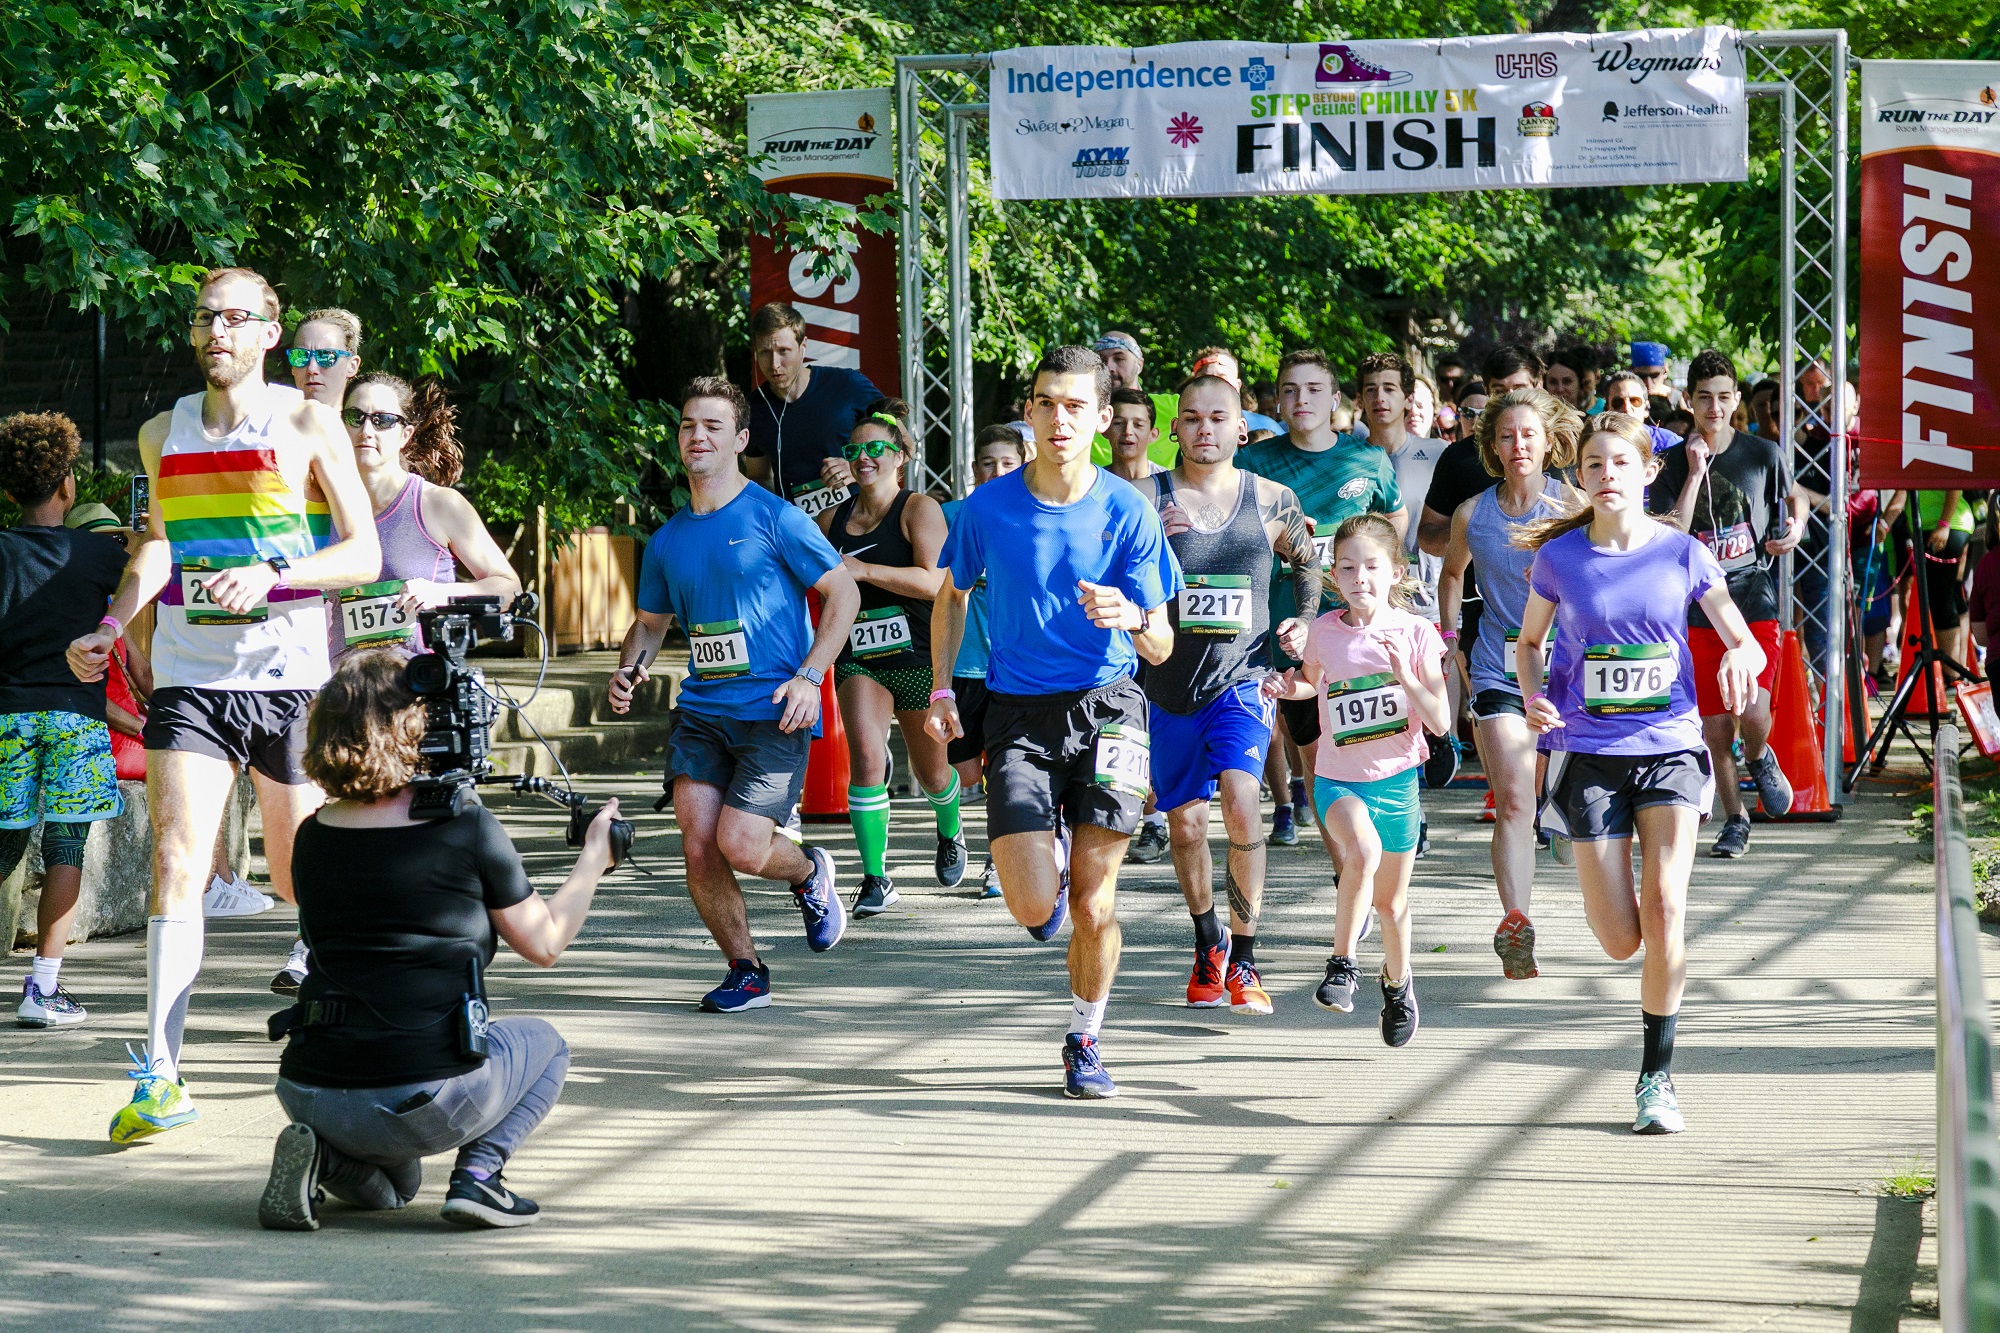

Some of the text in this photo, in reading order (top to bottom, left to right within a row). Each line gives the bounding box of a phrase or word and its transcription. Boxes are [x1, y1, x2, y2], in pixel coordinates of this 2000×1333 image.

[1495, 51, 1558, 79] UHS
[1592, 42, 1723, 84] Wegmans
[1008, 60, 1232, 98] Independence
[1251, 93, 1311, 118] STEP
[1312, 92, 1356, 103] BEYOND
[1312, 103, 1356, 116] CELIAC
[1360, 88, 1479, 115] PHILLY 5K
[1520, 117, 1556, 126] CANYON
[1623, 104, 1682, 117] Jefferson
[1878, 110, 1997, 123] RUN THE DAY
[1082, 115, 1134, 133] Megan
[1895, 125, 1979, 134] Race Management
[763, 136, 877, 153] RUN THE DAY
[1075, 146, 1130, 161] KYW
[1236, 117, 1496, 174] FINISH
[780, 152, 860, 163] Race Management
[1075, 165, 1127, 178] 1060
[1899, 163, 1974, 472] FINISH
[801, 487, 844, 515] 2126
[348, 601, 407, 631] 1573
[1187, 594, 1245, 616] 2217
[854, 621, 903, 646] 2178
[694, 639, 737, 663] 2081
[1595, 666, 1661, 693] 1976
[1335, 692, 1398, 726] 1975
